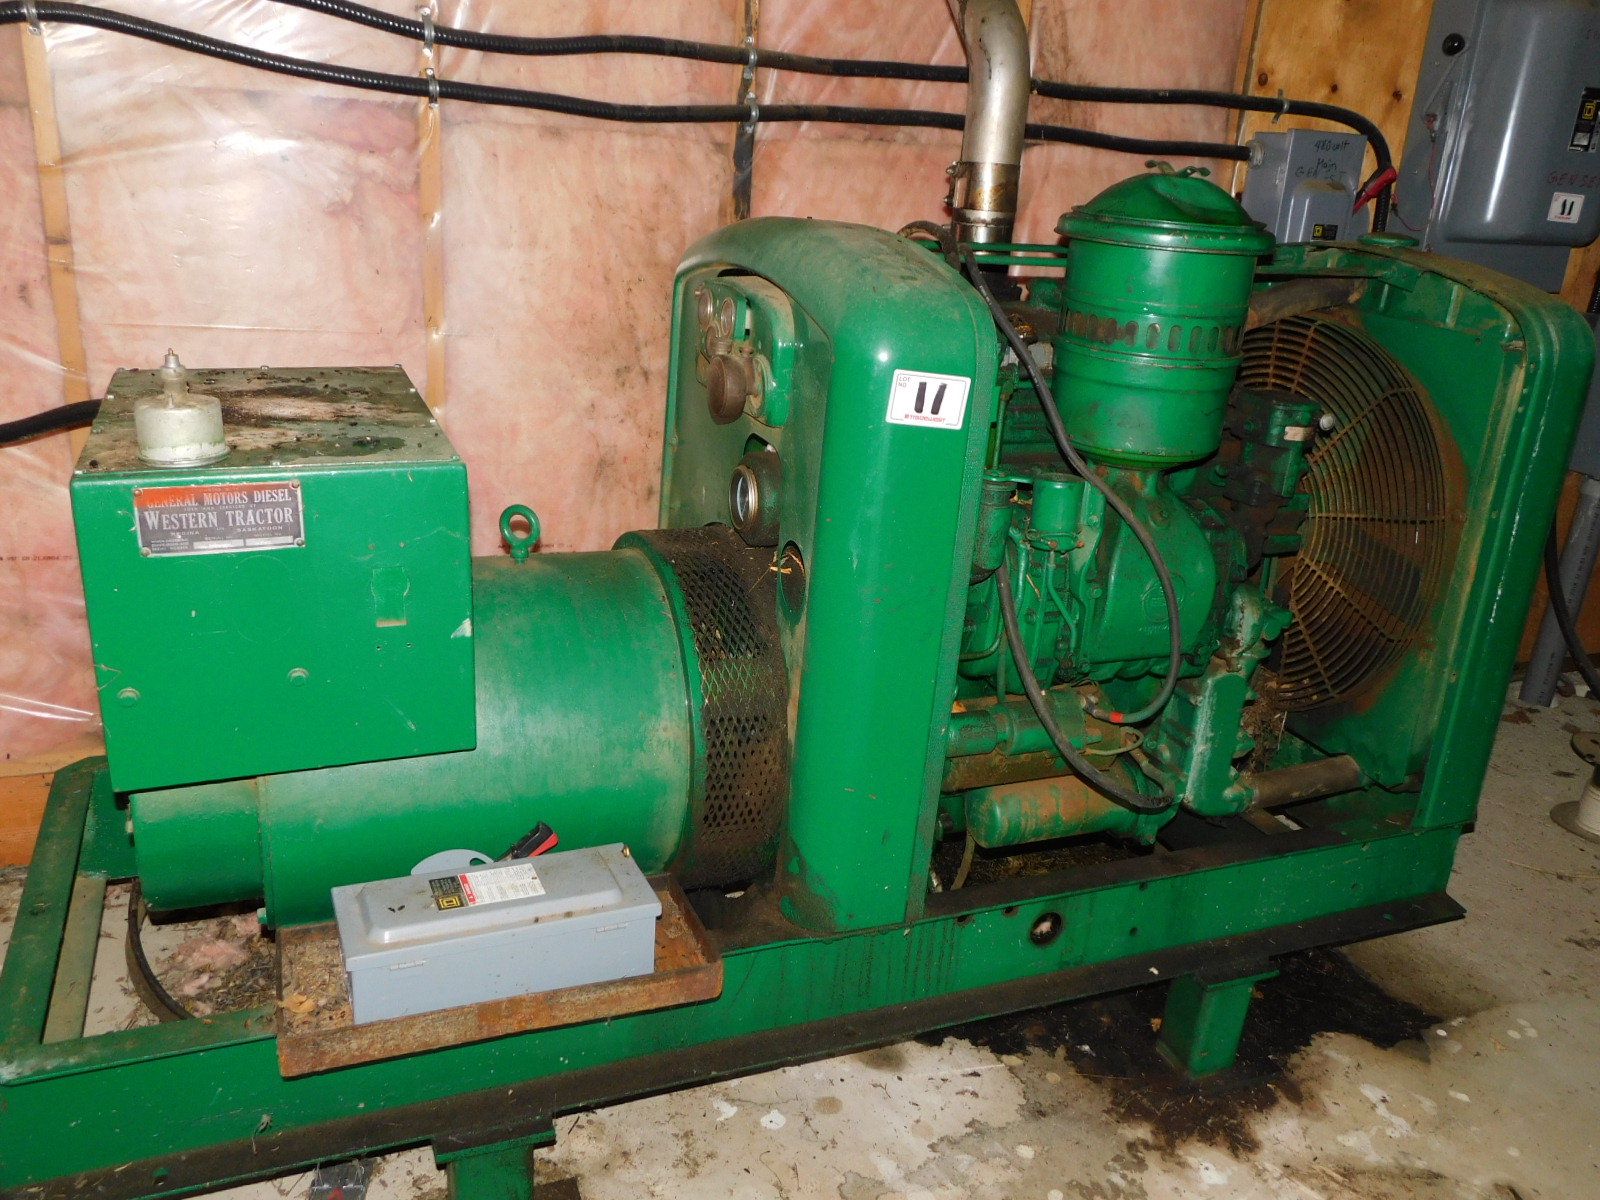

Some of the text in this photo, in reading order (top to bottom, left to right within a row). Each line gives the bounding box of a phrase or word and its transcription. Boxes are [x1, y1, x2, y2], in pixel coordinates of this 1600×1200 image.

[1547, 171, 1600, 189] GEN SE
[1560, 198, 1575, 216] 11
[914, 381, 948, 415] 11
[146, 488, 292, 508] GENERAL MOTORS DIESEL
[143, 507, 294, 531] WESTERN TRACTOR
